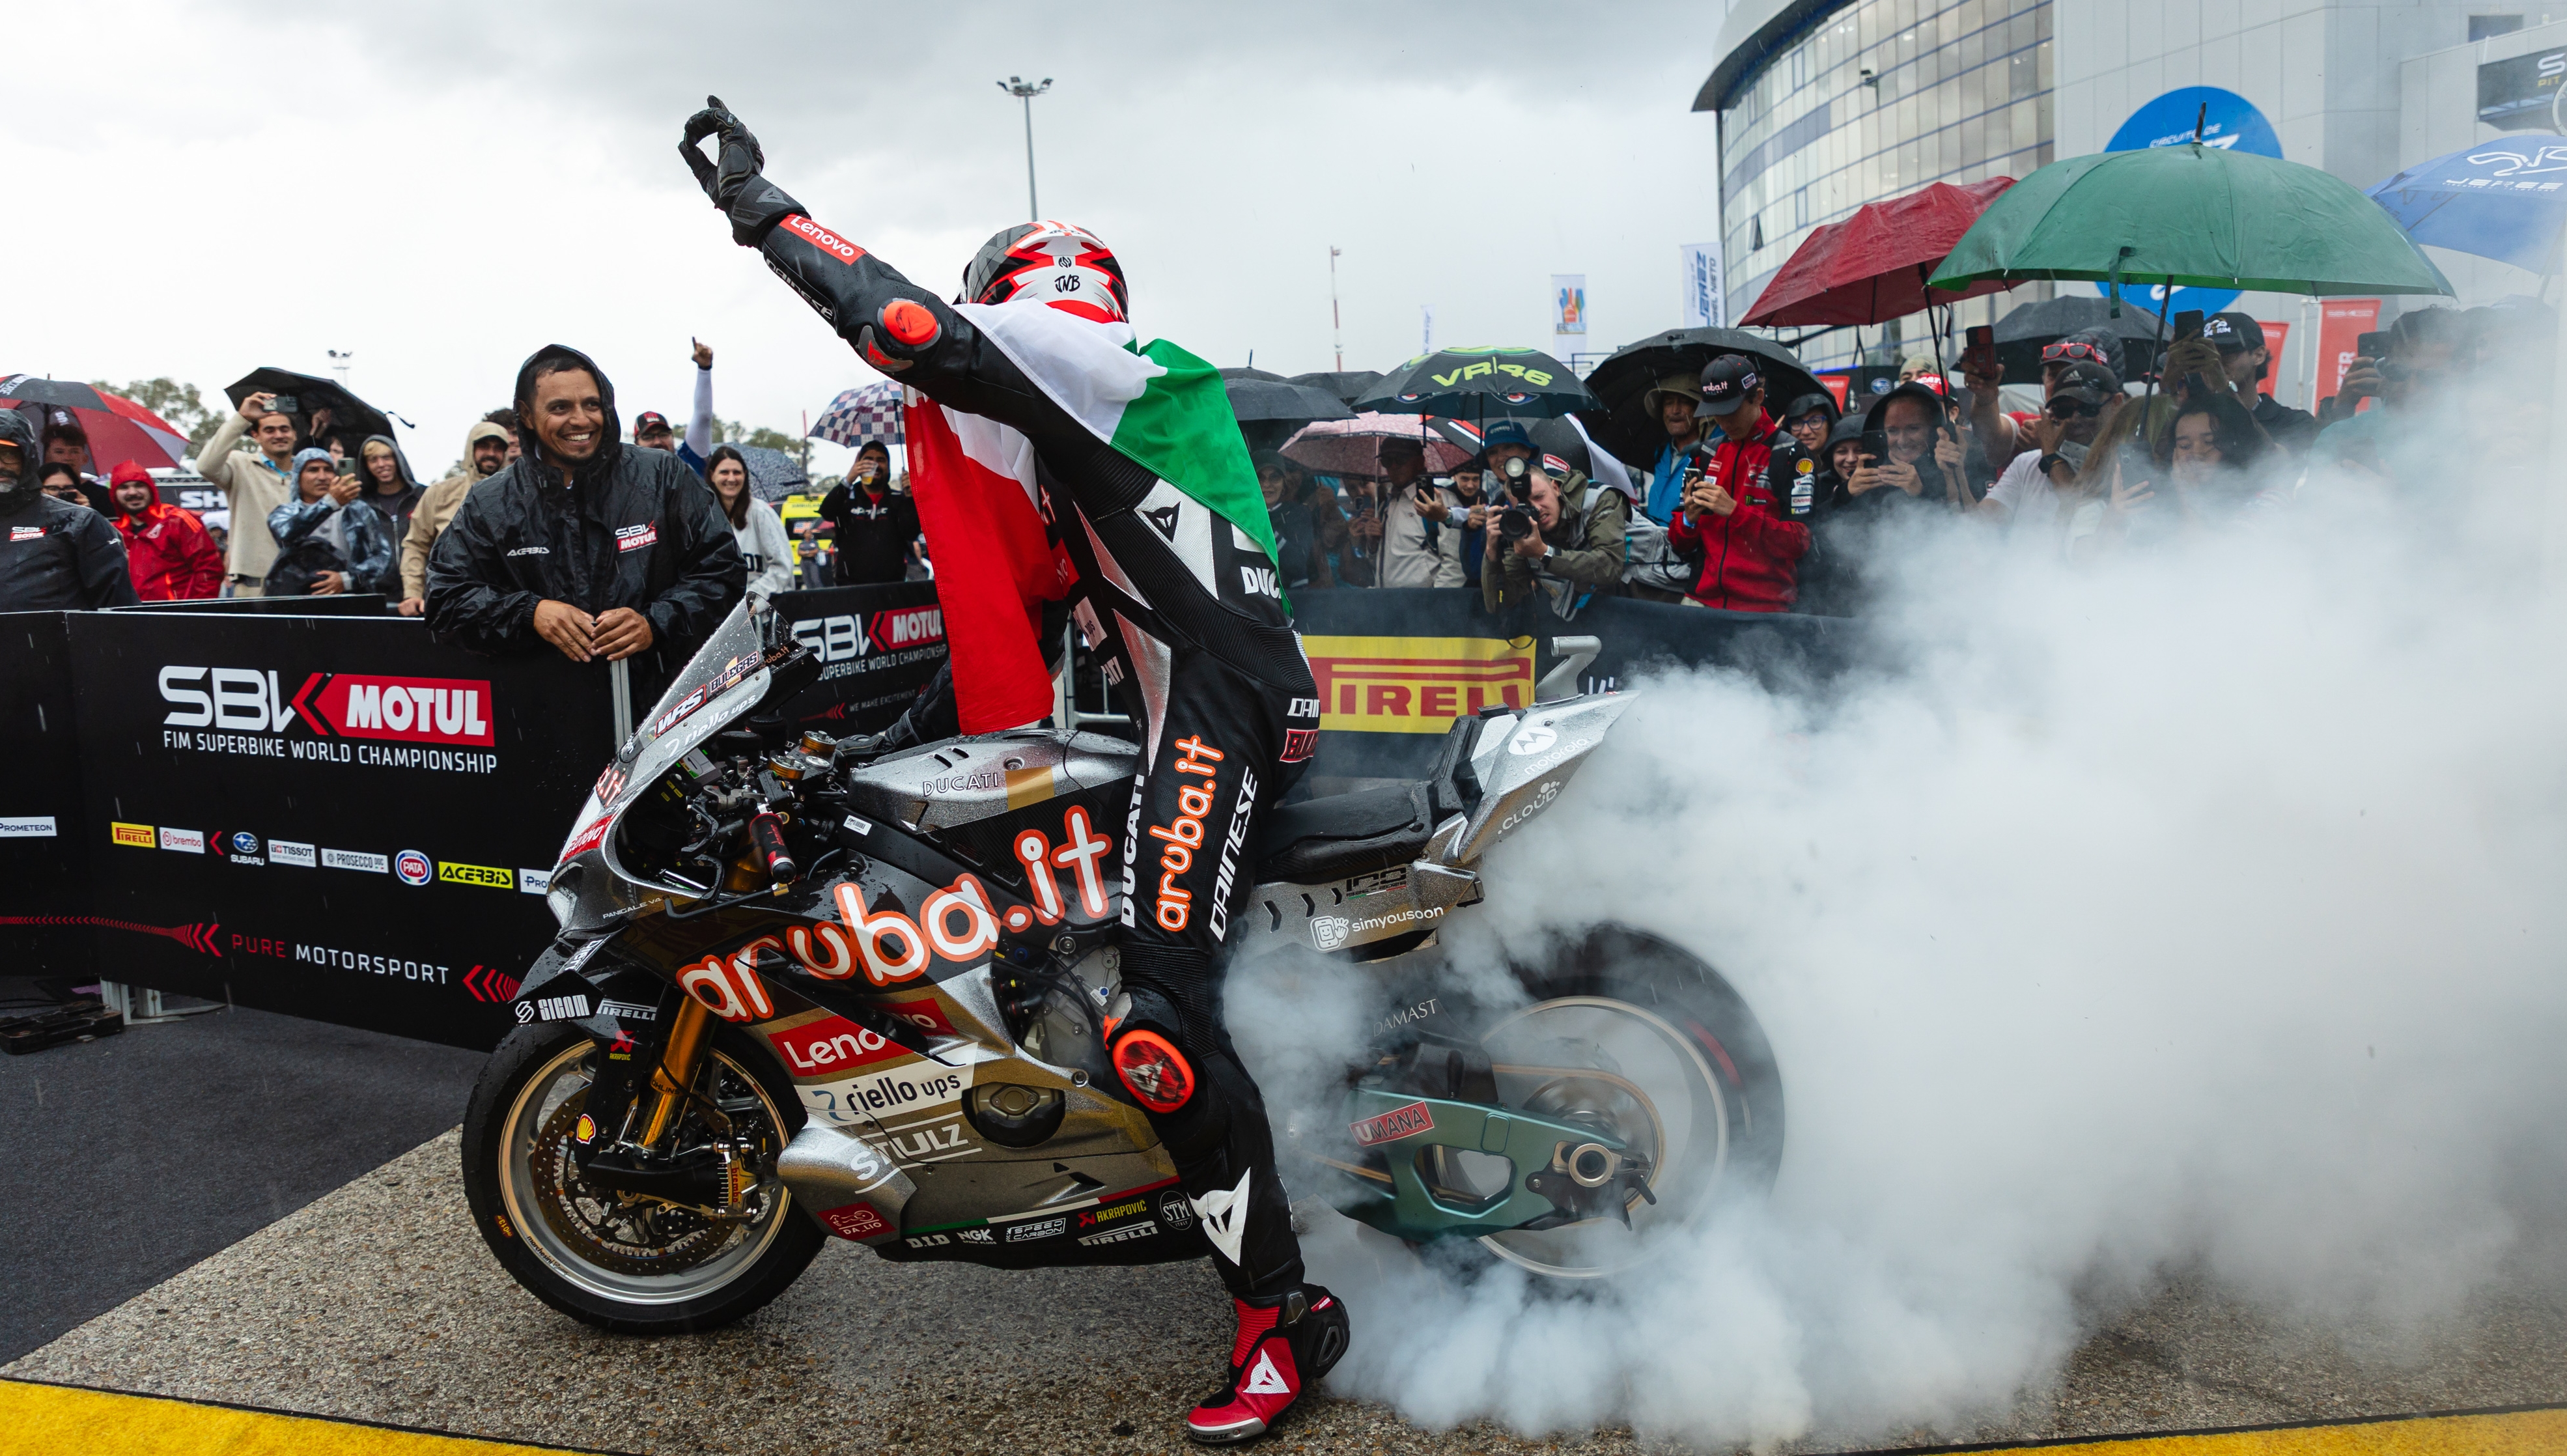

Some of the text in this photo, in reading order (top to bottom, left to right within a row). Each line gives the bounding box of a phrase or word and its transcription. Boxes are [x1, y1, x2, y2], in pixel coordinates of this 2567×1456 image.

[2203, 122, 2222, 136] DE
[790, 216, 854, 257] Lenovo
[620, 531, 657, 550] MOTUL
[868, 653, 897, 670] WORLD
[899, 643, 947, 665] CHAMPIONSHIP
[710, 651, 759, 693] BULEGAS
[158, 665, 329, 736] SBK
[346, 684, 486, 736] MOTUL
[656, 687, 703, 735] WRS
[849, 689, 916, 712] WE MAKE EXCITEMENT
[684, 693, 756, 746] riello ups
[163, 730, 497, 774] FIM SUPERBIKE WORLD CHAMPIONSHIP
[1524, 738, 1589, 775] motorola
[923, 772, 998, 797] DUCATI
[115, 827, 152, 845] PIRELLI
[172, 835, 202, 848] brembo
[1149, 735, 1224, 932] aruba.it
[231, 854, 265, 867] SUBARU
[282, 845, 313, 858] TISSOT
[336, 853, 373, 869] PROSECCO
[1121, 774, 1145, 929] DUCATI
[1209, 766, 1257, 942] DAINESE
[402, 861, 425, 875] PATA
[602, 901, 649, 919] PANIGALE
[647, 897, 662, 906] V4
[675, 805, 1113, 1022] aruba.it
[1352, 906, 1444, 932] simyousoon
[232, 934, 449, 985] PURE MOTORSPORT
[538, 994, 590, 1021] SICOM
[596, 999, 658, 1021] PIRELLI
[1373, 998, 1437, 1037] DAMAST
[846, 1074, 962, 1115] riello ups
[1354, 1108, 1427, 1142] UMANA
[850, 1123, 969, 1181] STULZ
[731, 1166, 740, 1204] brembo
[1162, 1200, 1191, 1222] STM
[956, 1228, 994, 1241] NGK
[1013, 1225, 1063, 1240] CARBON
[1014, 1220, 1063, 1235] SPEED
[1077, 1220, 1158, 1246] PIRELLI
[526, 1235, 555, 1265] marchesini
